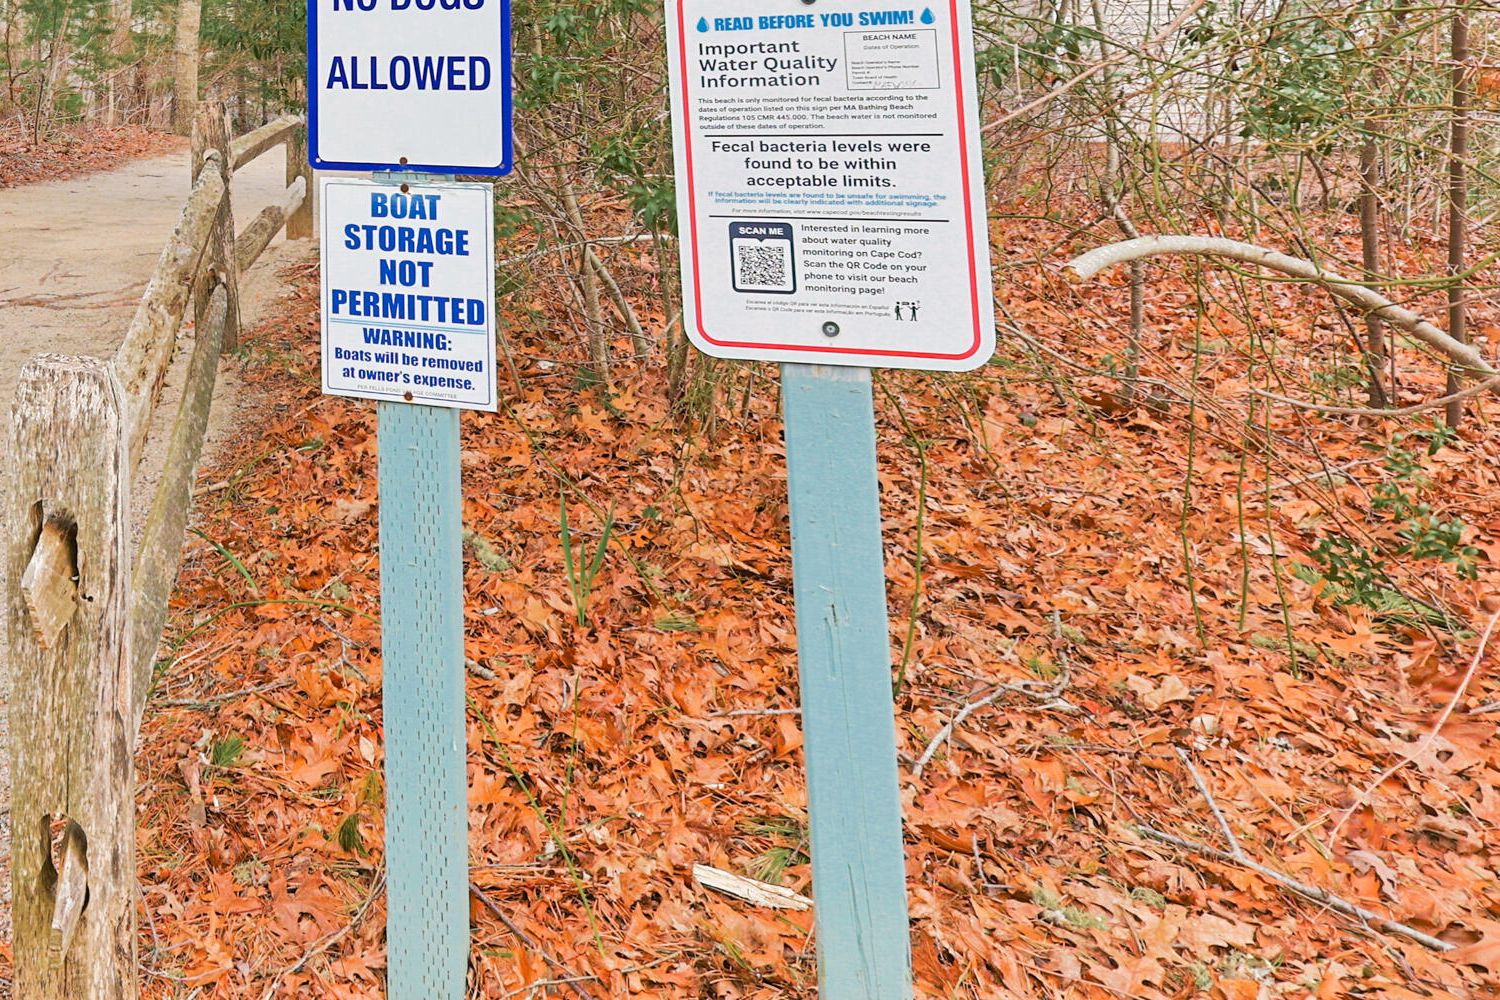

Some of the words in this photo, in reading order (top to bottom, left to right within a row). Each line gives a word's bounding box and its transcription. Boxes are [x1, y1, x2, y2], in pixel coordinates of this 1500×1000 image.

[714, 17, 753, 31] READ
[758, 14, 815, 29] BEFORE
[819, 12, 853, 27] YOU
[858, 10, 914, 26] SWIM!
[699, 41, 800, 58] Important
[699, 59, 758, 71] Water
[763, 56, 837, 72] Quality
[326, 55, 491, 90] ALLOWED
[701, 72, 820, 88] Information
[712, 140, 754, 152] Fecal
[759, 140, 827, 152] bacteria
[832, 140, 882, 152] levels
[887, 143, 930, 152] were
[744, 157, 791, 169] found
[796, 158, 813, 169] to
[818, 157, 839, 169] be
[844, 157, 896, 170] within
[747, 174, 837, 189] acceptable
[843, 174, 896, 187] limits.
[371, 192, 441, 220] BOAT
[738, 226, 766, 234] SCAN
[768, 227, 784, 235] ME
[801, 224, 848, 232] Interested
[862, 225, 901, 235] learning
[344, 223, 469, 256] STORAGE
[802, 236, 828, 244] about
[859, 238, 891, 247] quality
[802, 248, 853, 258] monitoring
[870, 249, 895, 259] Cape
[897, 250, 922, 259] Cod?
[803, 259, 826, 268] Scan
[828, 260, 844, 268] the
[846, 261, 860, 269] QR
[862, 261, 888, 270] Code
[379, 259, 433, 287] NOT
[804, 272, 833, 281] phone
[847, 273, 868, 281] visit
[888, 275, 918, 283] beach
[805, 284, 856, 295] monitoring
[858, 287, 885, 295] page!
[332, 289, 485, 326] PERMITTED
[362, 327, 452, 351] WARNING:
[335, 347, 371, 362] Boats
[374, 351, 398, 364] will
[402, 353, 418, 366] be
[422, 357, 482, 372] removed
[342, 367, 355, 378] at
[358, 369, 410, 384] owner's
[413, 374, 475, 390] expense.
